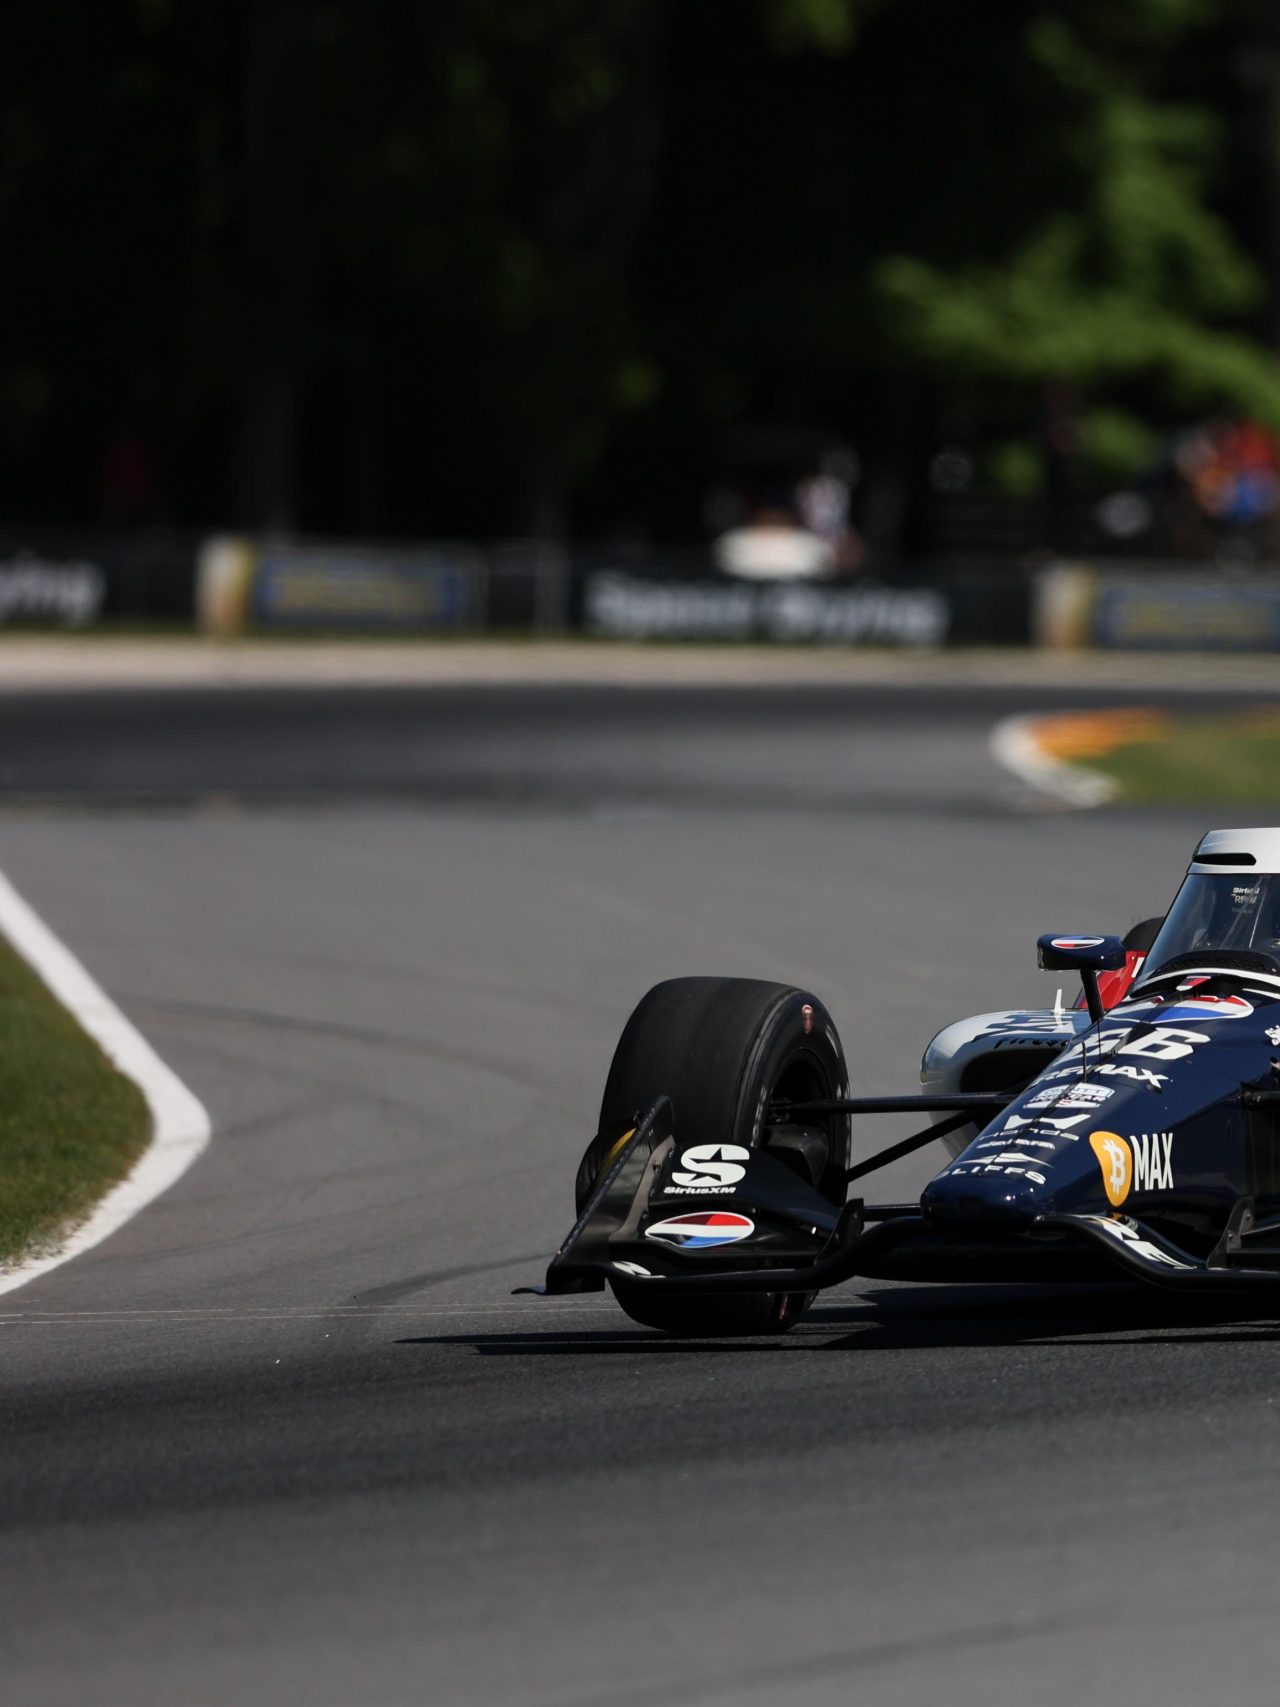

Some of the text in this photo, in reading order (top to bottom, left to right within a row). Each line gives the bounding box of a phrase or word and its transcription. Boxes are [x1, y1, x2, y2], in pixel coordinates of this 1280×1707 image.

[1030, 1063, 1169, 1089] REMAX
[1130, 1132, 1174, 1192] MAX
[664, 1187, 737, 1195] SiriusXM
